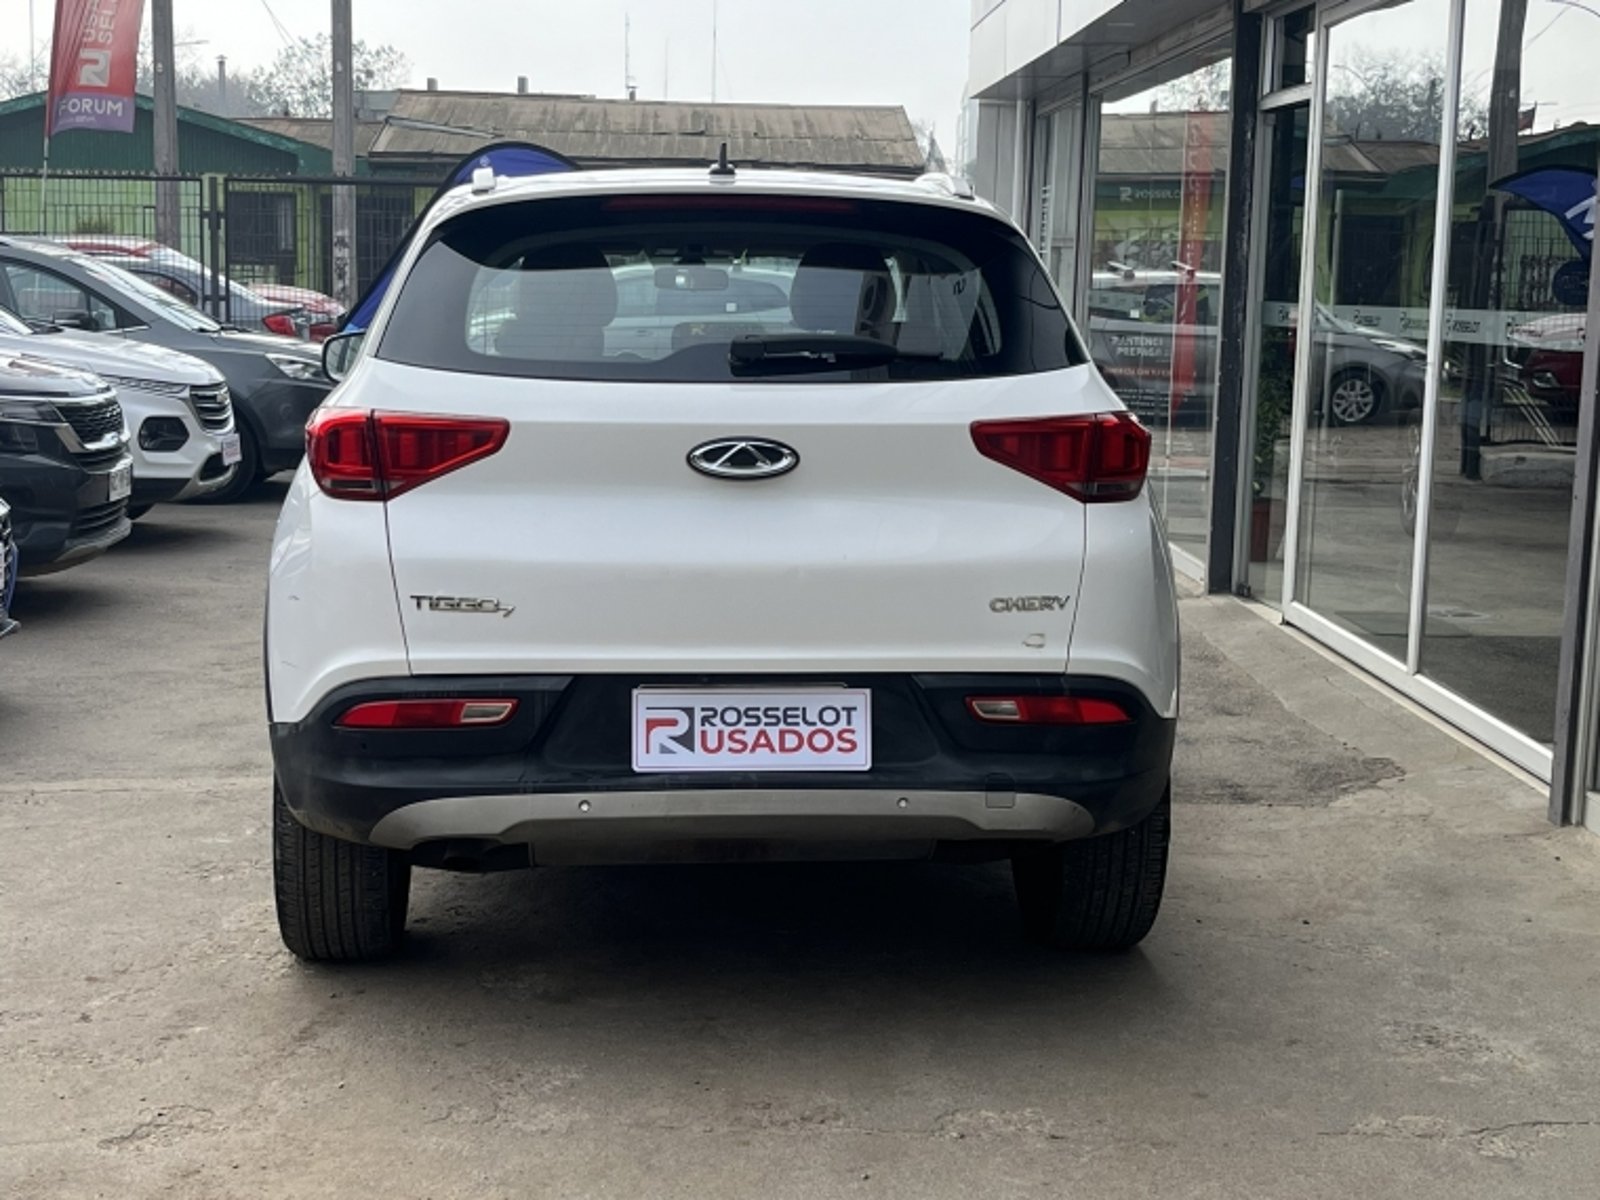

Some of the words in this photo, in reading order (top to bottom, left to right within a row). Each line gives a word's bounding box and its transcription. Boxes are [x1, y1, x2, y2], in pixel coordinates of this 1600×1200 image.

[59, 98, 123, 117] FORUM
[989, 595, 1070, 613] CHERY
[700, 706, 858, 727] ROSSELOT
[700, 729, 858, 754] USADOS
